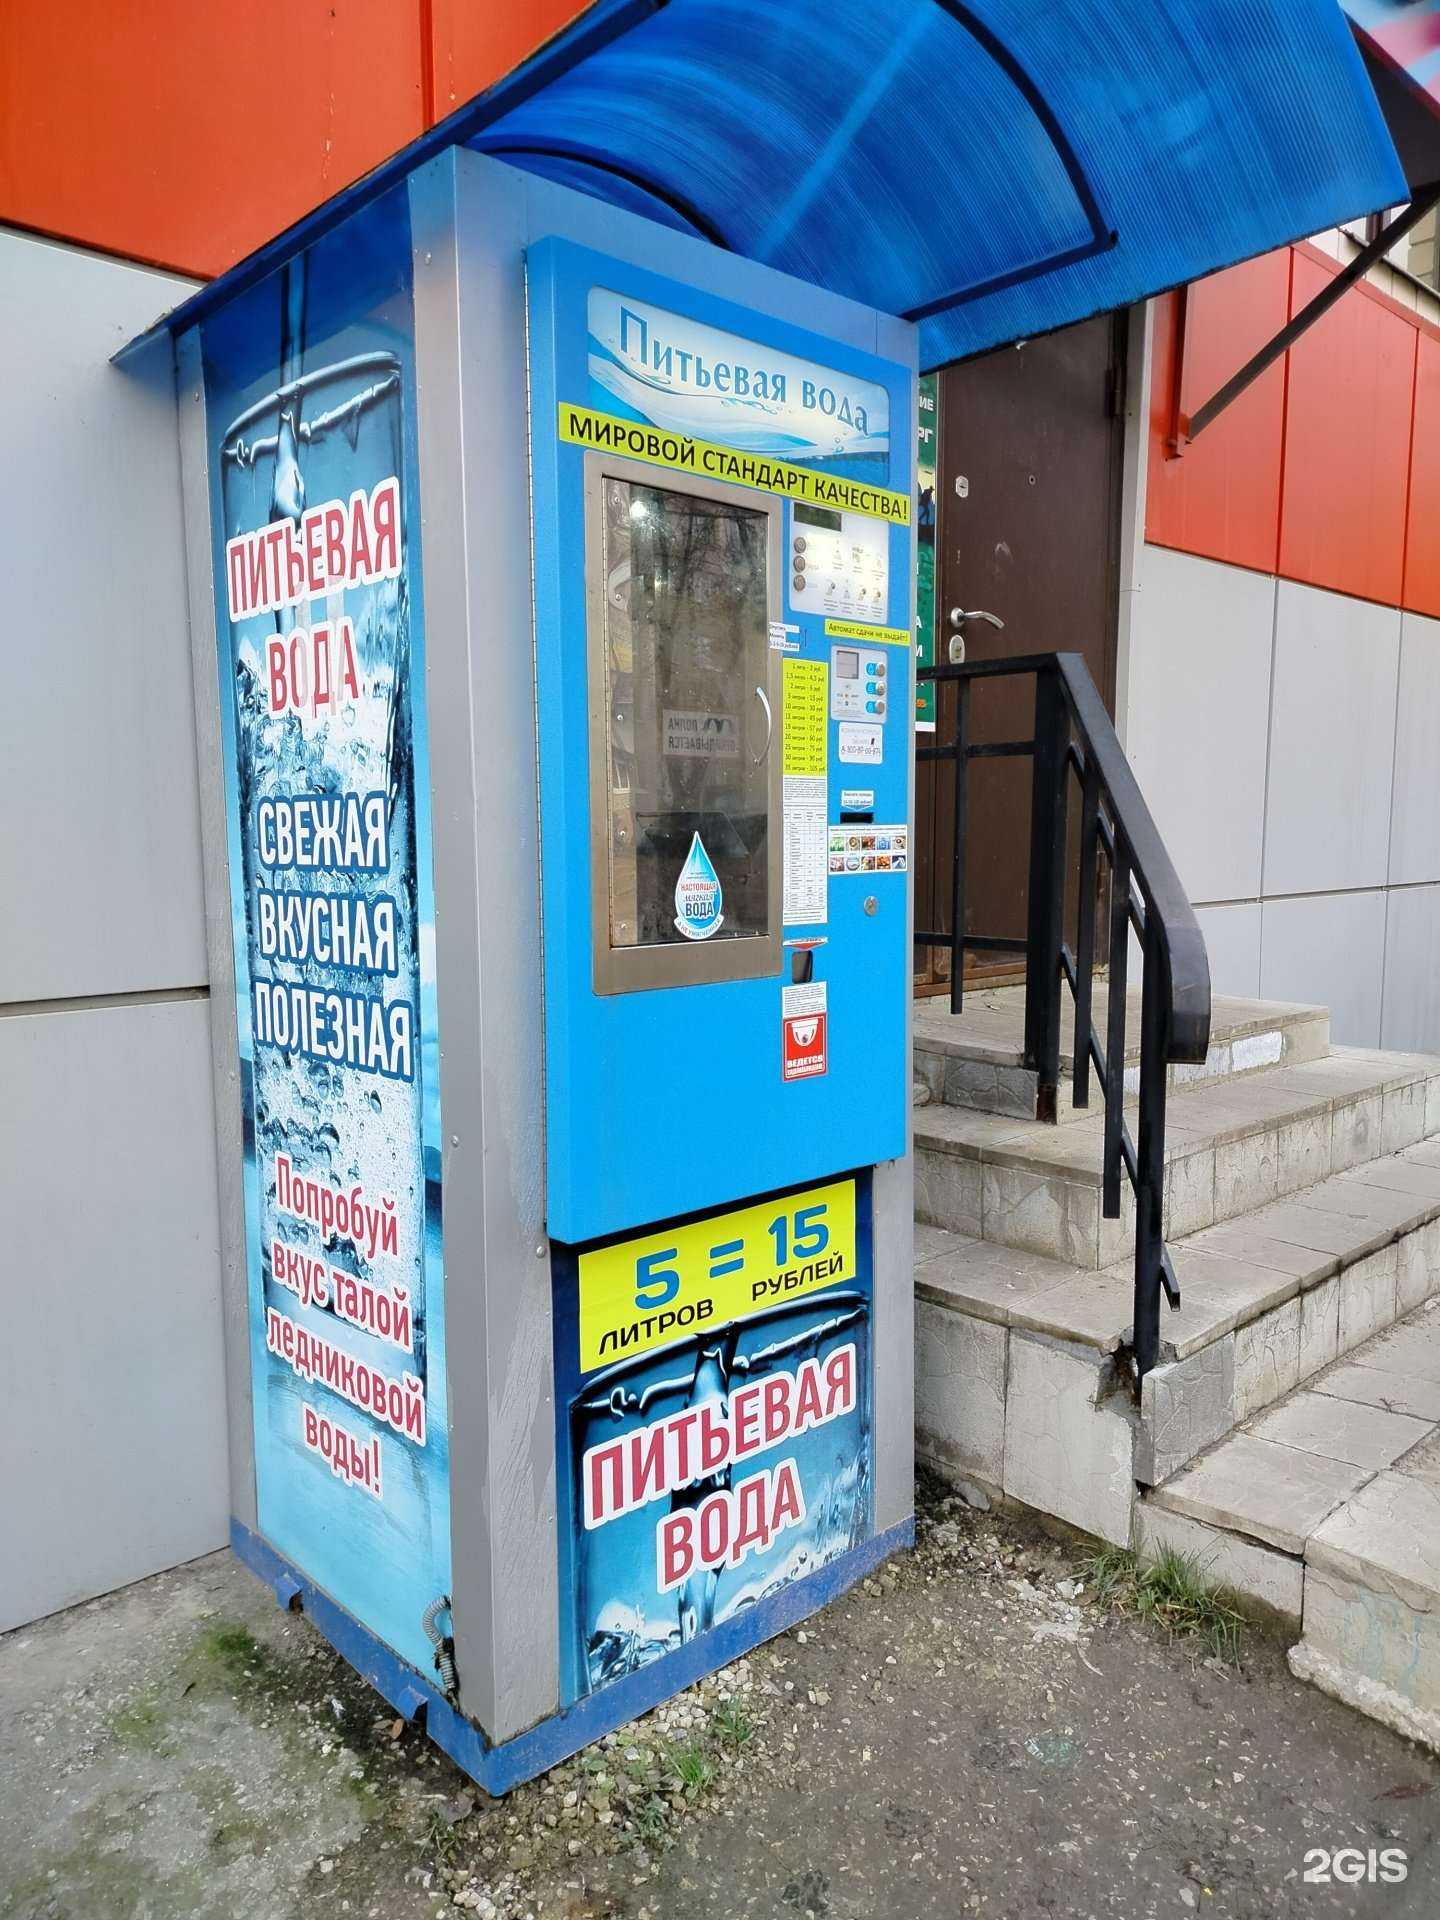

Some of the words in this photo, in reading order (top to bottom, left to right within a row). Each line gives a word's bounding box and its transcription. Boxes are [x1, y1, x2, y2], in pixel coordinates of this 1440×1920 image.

[620, 305, 787, 404] Питьевая
[802, 379, 871, 437] вода
[569, 413, 696, 467] МИРОВОЙ
[702, 451, 809, 495] СТАНДАРТ
[814, 479, 908, 520] КАЧЕСТВА!
[229, 486, 398, 614] ПИТЬЕВАЯ
[269, 624, 359, 718] ВОДА
[259, 797, 387, 868] СВЕЖАЯ
[260, 893, 396, 972] ВКУСНАЯ
[685, 902, 714, 917] ВОДА
[255, 981, 411, 1077] ПОЛЕЗНАЯ
[276, 1156, 398, 1259] Попробуй
[635, 1247, 680, 1310] 5
[768, 1203, 830, 1267] 15
[273, 1242, 326, 1305] вкус
[333, 1270, 411, 1348] талой
[598, 1298, 714, 1356] ЛИТРОВ
[751, 1251, 844, 1302] РУБЛЕЙ
[268, 1312, 423, 1440] ледниковой
[305, 1407, 381, 1493] воды!
[590, 1350, 851, 1522] ПИТЬЕВАЯ
[662, 1464, 801, 1587] ВОДА
